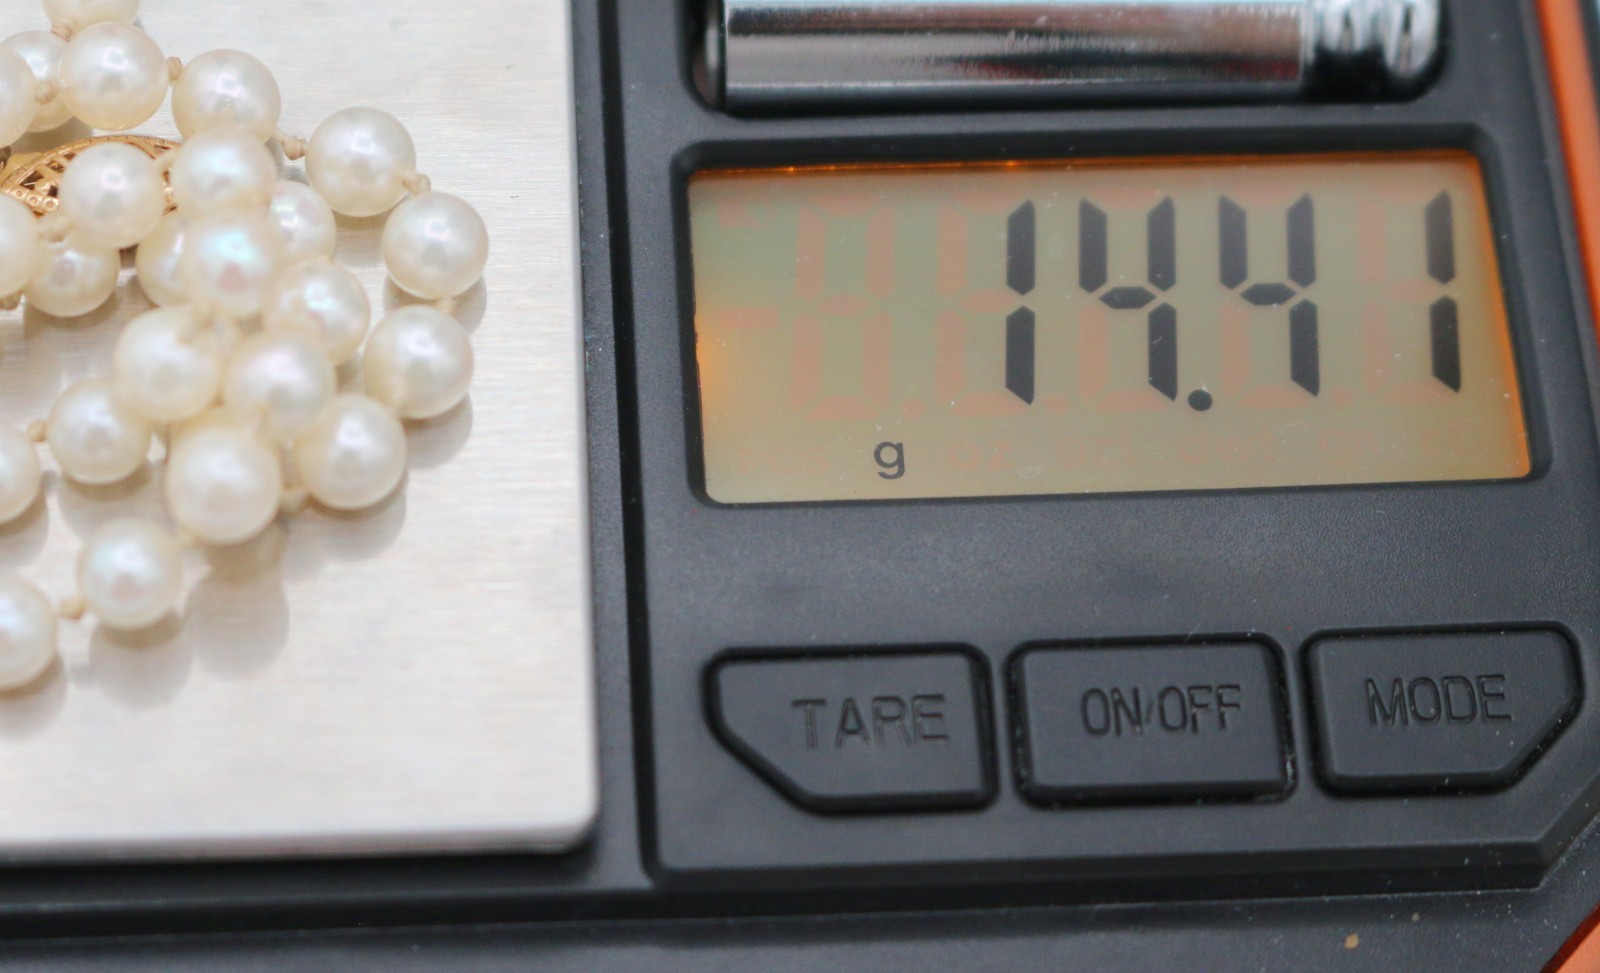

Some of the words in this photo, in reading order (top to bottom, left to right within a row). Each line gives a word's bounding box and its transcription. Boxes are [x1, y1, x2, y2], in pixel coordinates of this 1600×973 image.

[1006, 189, 1460, 413] 14.41
[873, 441, 906, 480] g
[791, 693, 949, 748] TARE
[1081, 684, 1241, 736] ON/OFF
[1365, 674, 1512, 725] MODE
